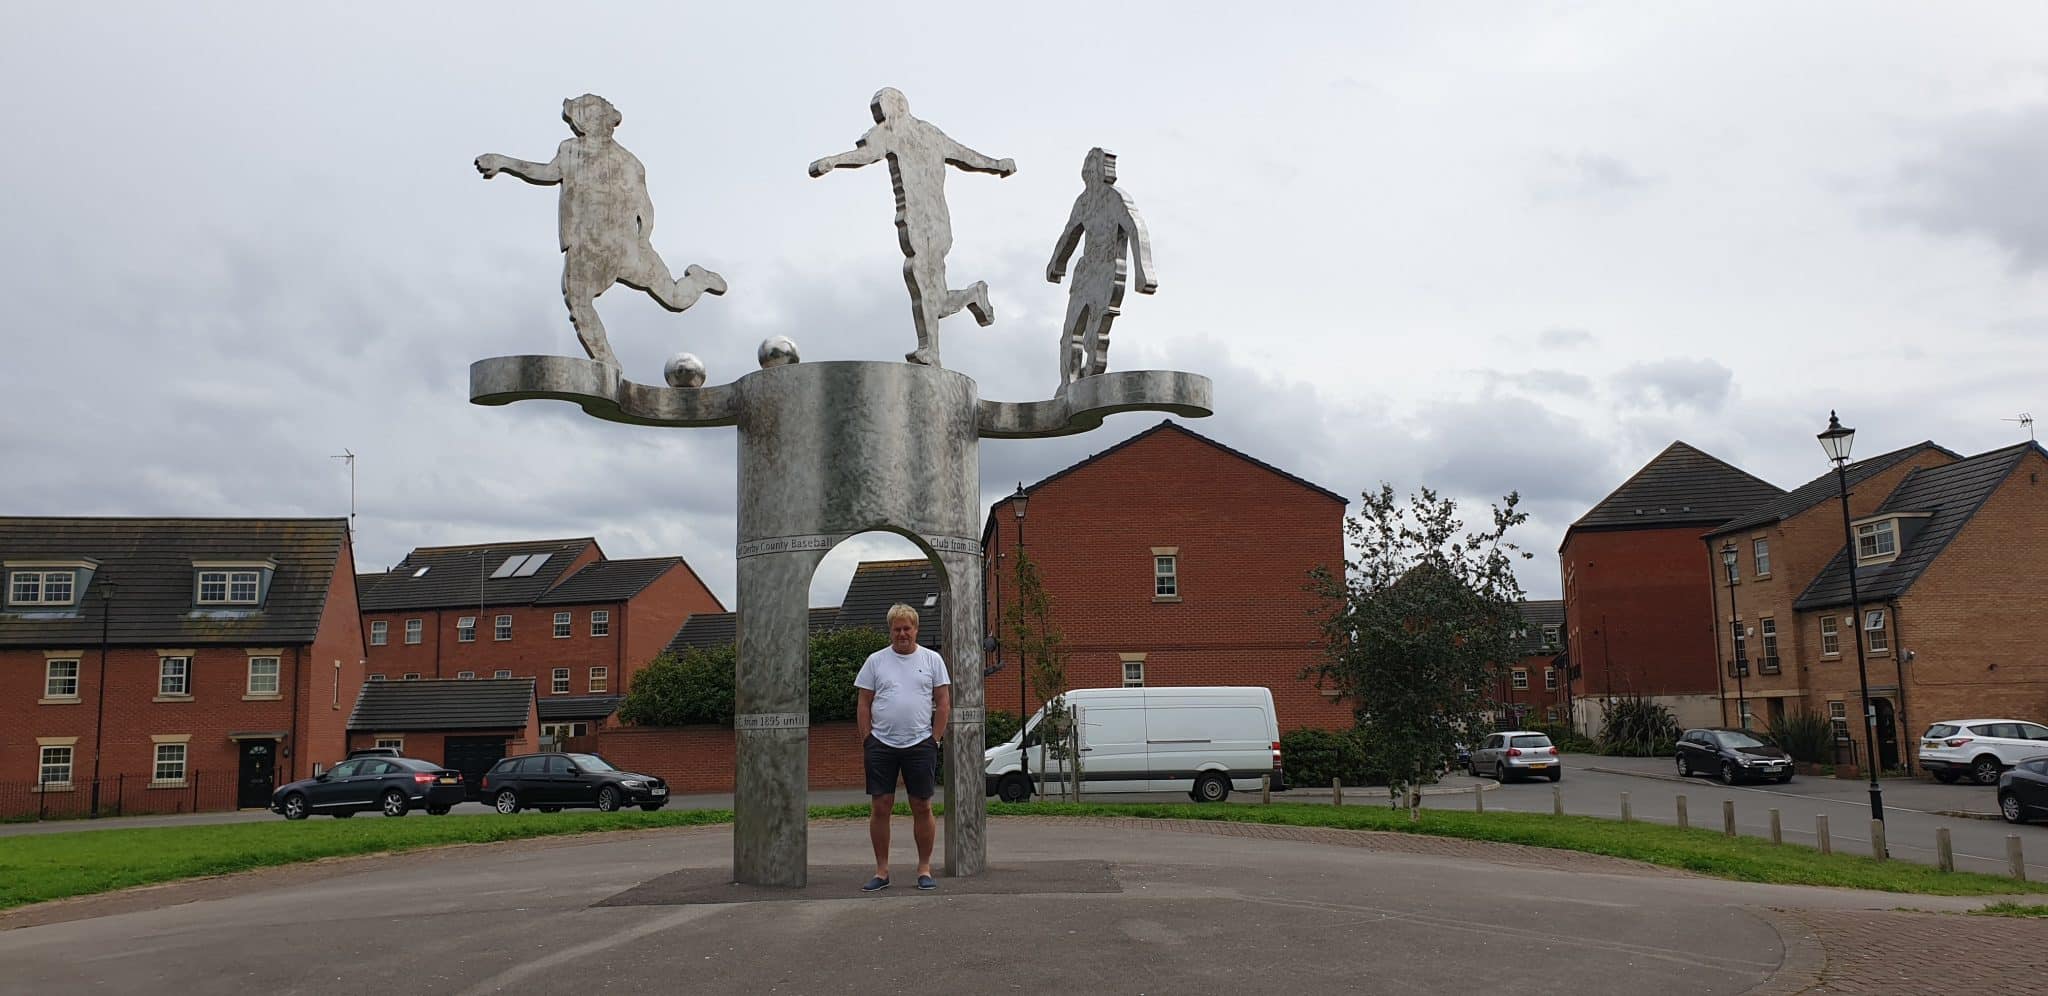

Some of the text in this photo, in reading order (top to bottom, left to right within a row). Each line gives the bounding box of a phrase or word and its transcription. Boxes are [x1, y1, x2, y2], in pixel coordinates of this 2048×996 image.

[760, 540, 789, 552] County
[791, 537, 833, 549] Baseball
[931, 537, 949, 548] Club
[951, 539, 967, 550] from
[760, 716, 781, 727] 1895
[783, 715, 805, 726] until
